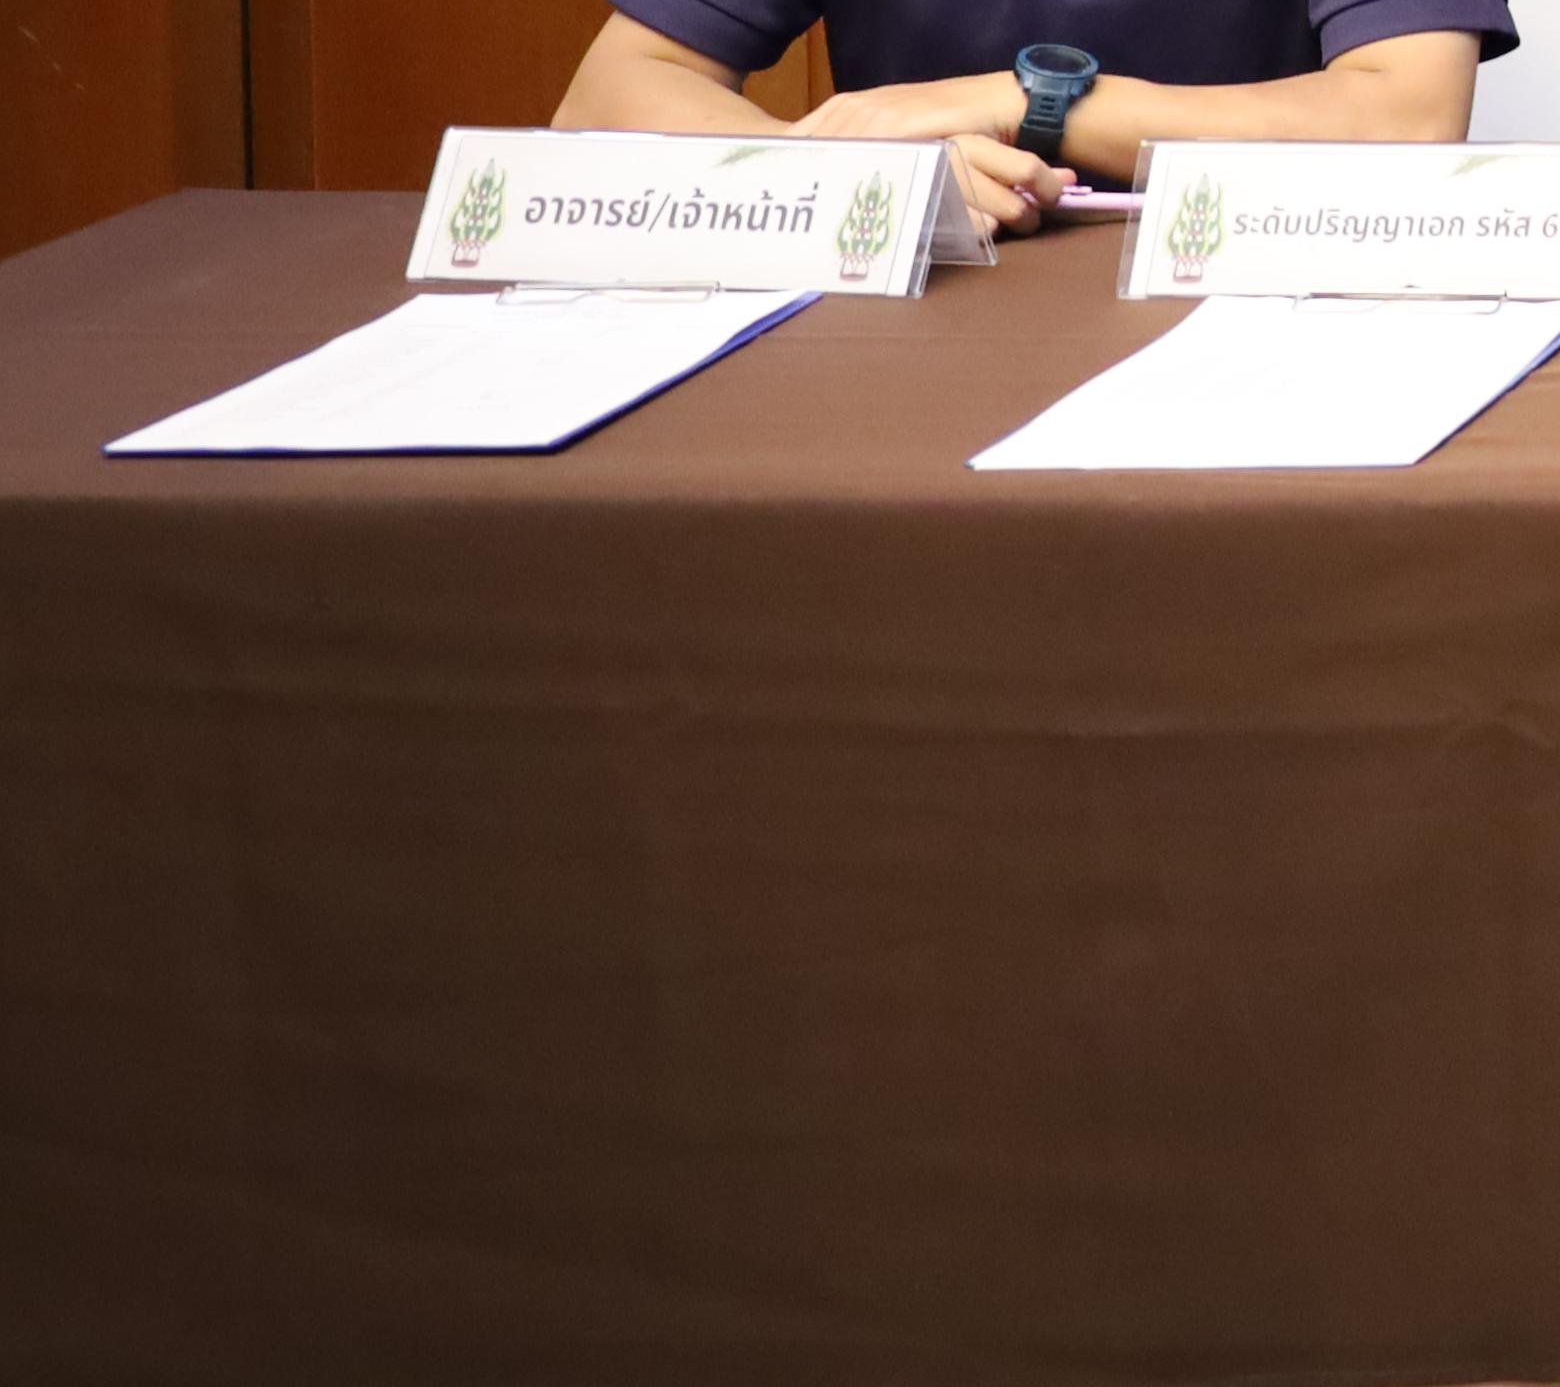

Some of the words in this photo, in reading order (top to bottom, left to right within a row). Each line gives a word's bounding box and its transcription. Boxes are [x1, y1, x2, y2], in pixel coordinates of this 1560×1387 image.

[524, 181, 819, 233] อาจารย์/เจ้าหน้าที่
[1233, 205, 1465, 244] ระดับปริญญาเอก
[1476, 207, 1531, 238] รหัส
